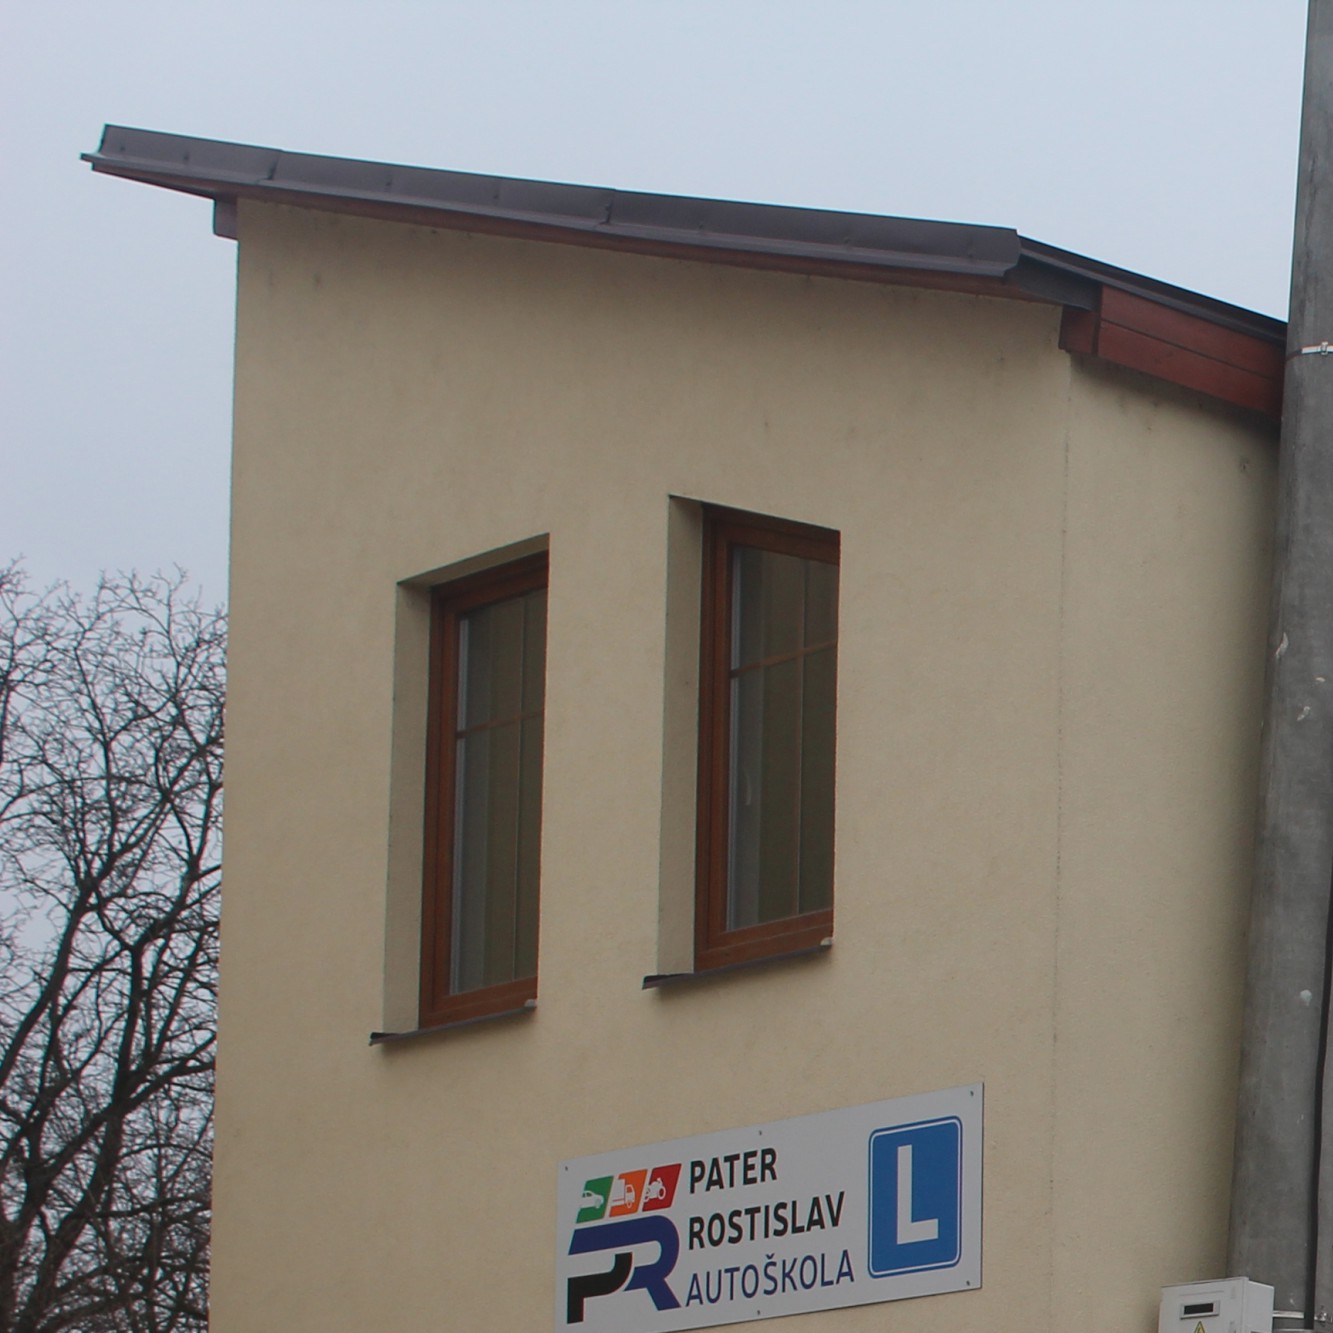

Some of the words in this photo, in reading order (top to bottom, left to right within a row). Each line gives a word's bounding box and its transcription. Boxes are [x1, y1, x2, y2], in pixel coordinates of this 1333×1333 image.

[689, 1147, 778, 1194] PATER
[896, 1144, 939, 1245] L
[688, 1191, 845, 1251] ROSTISLAV
[685, 1249, 855, 1307] AUTOŠKOLA
